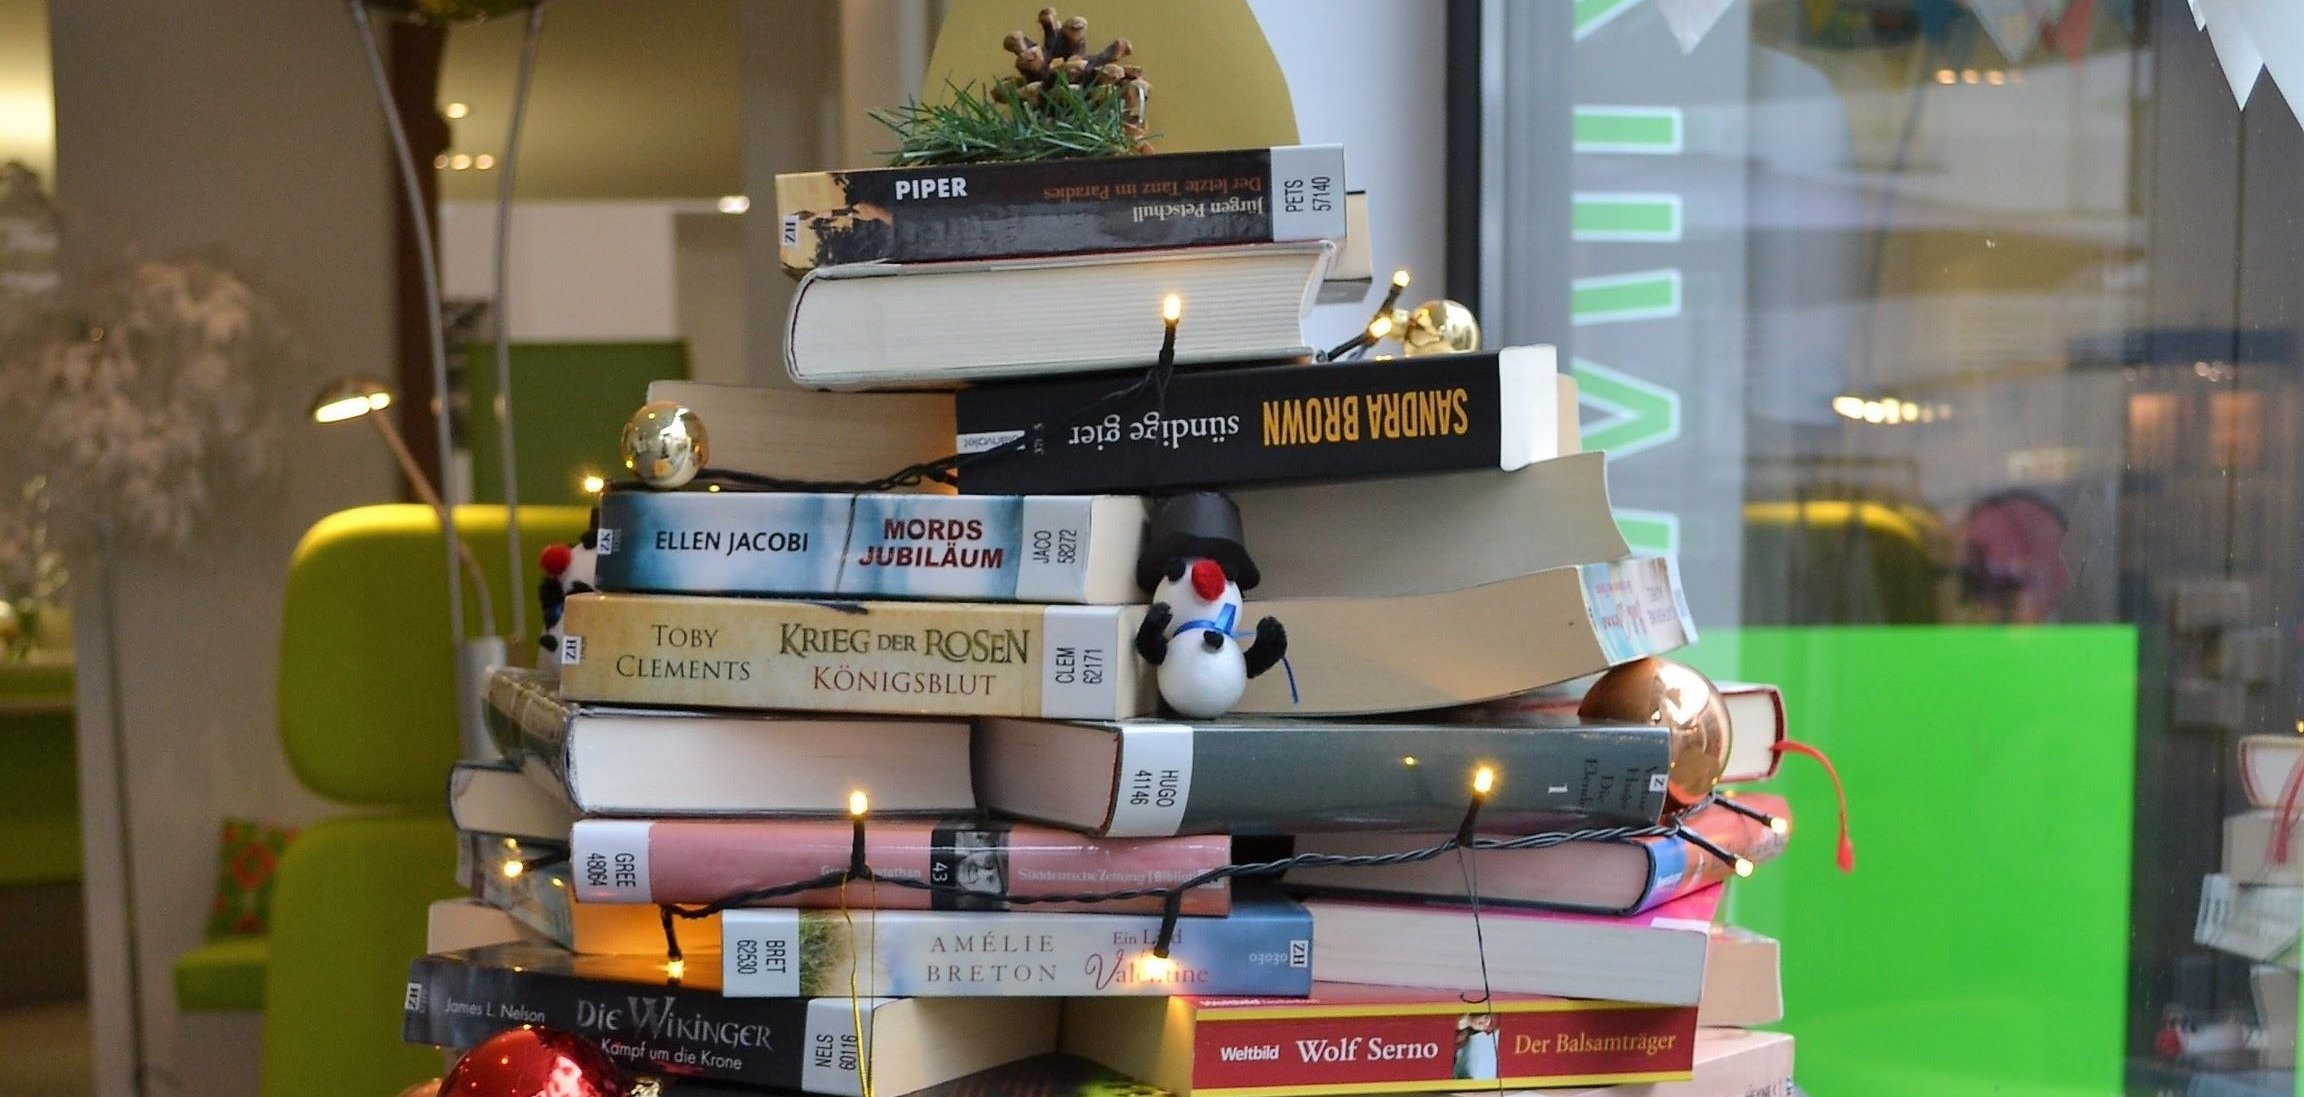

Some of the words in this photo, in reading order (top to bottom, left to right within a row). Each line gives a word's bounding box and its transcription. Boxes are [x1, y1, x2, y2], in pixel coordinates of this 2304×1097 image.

[895, 176, 968, 200] PIPER
[1043, 186, 1110, 203] Paradies
[1115, 184, 1137, 197] im
[1143, 182, 1181, 196] Tanz
[1186, 179, 1229, 194] letzte
[1233, 177, 1262, 191] Der
[1285, 179, 1304, 213] PETS
[1312, 176, 1331, 212] 57140
[1132, 202, 1205, 223] Petschull
[1211, 197, 1264, 218] Jürgen
[784, 221, 797, 243] ZH
[1262, 396, 1359, 446] BROWN
[1366, 388, 1470, 440] SANDRA
[1068, 414, 1121, 452] gier
[1130, 411, 1240, 450] sündige
[655, 530, 721, 551] ELLEN
[726, 532, 809, 557] JACOBI
[883, 518, 983, 541] MORDS
[858, 541, 1004, 569] JUBILÄUM
[1032, 530, 1052, 564] JACO
[1057, 529, 1078, 565] 58272
[564, 639, 577, 661] ZH
[651, 623, 720, 649] TOBY
[779, 623, 872, 660] KRIEG
[877, 632, 917, 653] DER
[924, 629, 1030, 664] ROSEN
[615, 654, 751, 682] CLEMENTS
[1055, 647, 1076, 685] CLEM
[1083, 649, 1104, 685] 62171
[813, 664, 997, 697] KÖNIGSBLUT
[1130, 769, 1153, 806] 41146
[1156, 769, 1180, 808] HUGO
[586, 852, 608, 887] 48064
[614, 852, 637, 888] GREE
[932, 861, 948, 883] 43
[931, 930, 1055, 954] AMÉLIE
[1112, 931, 1137, 945] Ein
[737, 939, 758, 975] 62530
[766, 939, 786, 974] BRET
[1292, 942, 1308, 966] ZH
[926, 963, 1057, 983] BRETON
[445, 997, 483, 1015] James
[501, 1004, 546, 1023] Nelson
[600, 1037, 647, 1061] Kampf
[649, 1048, 671, 1063] um
[674, 1048, 696, 1065] die
[701, 1050, 743, 1071] Krone
[815, 1033, 834, 1068] NELS
[839, 1034, 858, 1071] 60116
[1221, 1044, 1280, 1062] Weltbild
[1296, 1037, 1363, 1064] Wolf
[1367, 1037, 1440, 1061] Serno
[1514, 1034, 1551, 1055] Der
[1556, 1032, 1677, 1058] Balsamträger
